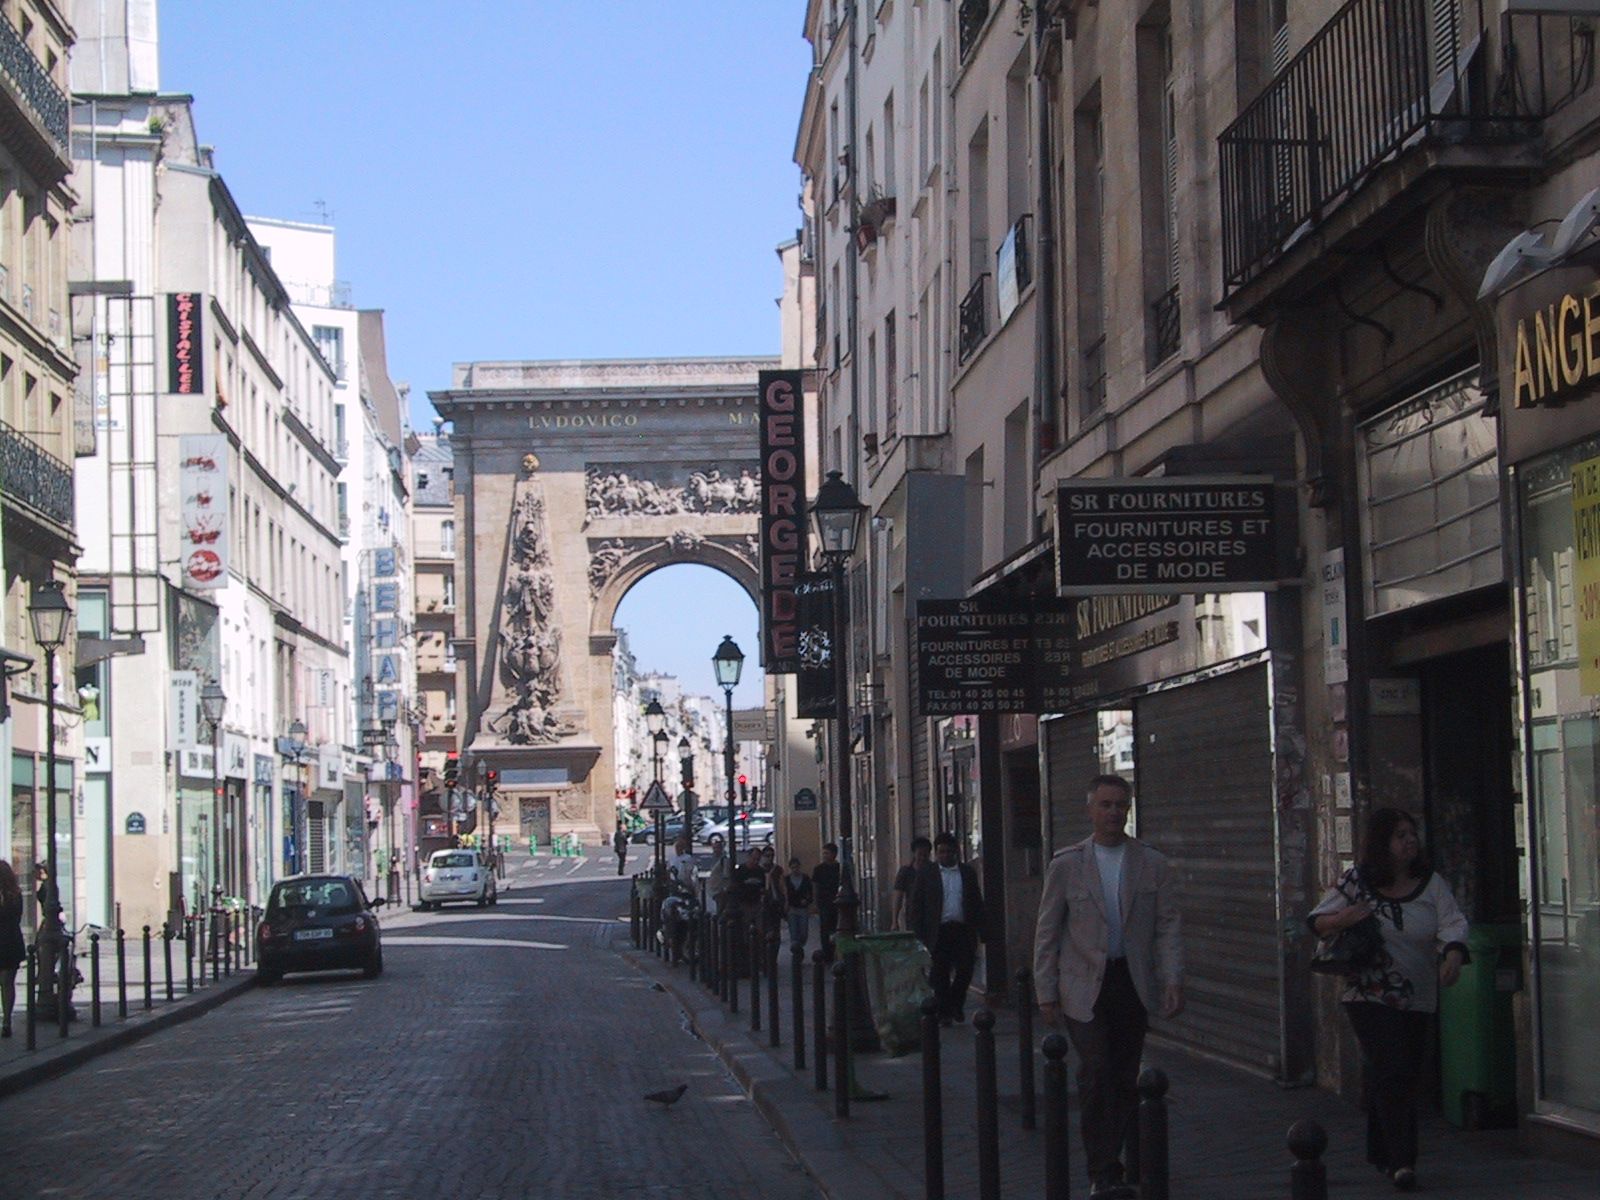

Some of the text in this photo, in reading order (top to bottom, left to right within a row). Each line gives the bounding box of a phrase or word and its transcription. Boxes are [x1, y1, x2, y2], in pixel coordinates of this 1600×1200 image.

[528, 414, 638, 430] LVDOVICO
[1070, 491, 1265, 511] SR FOURNITURES
[1074, 519, 1270, 538] FOURNITURES ET
[1087, 540, 1247, 558] ACCESSOIRES
[1116, 561, 1226, 580] DE MODE
[959, 601, 979, 613] SR
[918, 614, 1029, 628] FOURNITURES
[920, 640, 1029, 653] FOURNITURES ET
[928, 653, 1022, 666] ACCESSOIRES
[945, 666, 1006, 679] DE MODE
